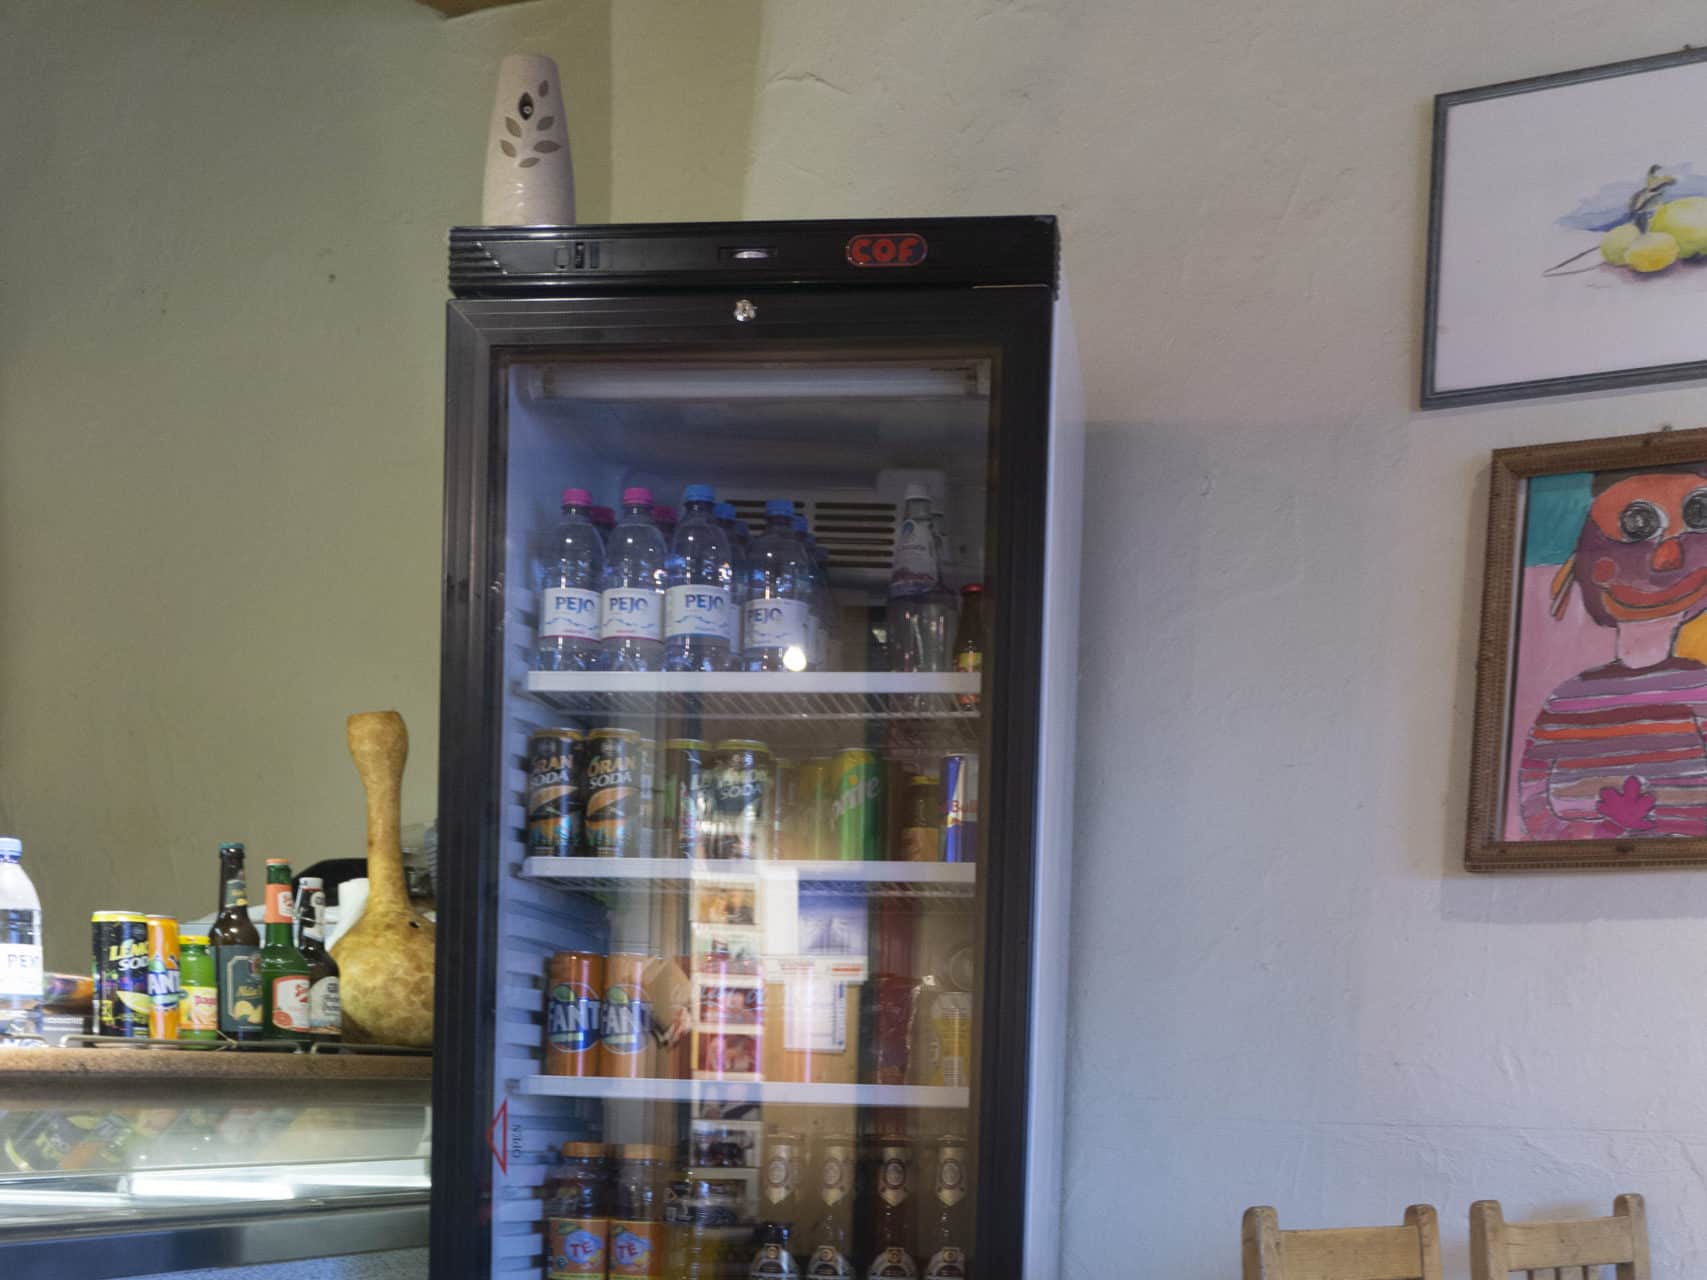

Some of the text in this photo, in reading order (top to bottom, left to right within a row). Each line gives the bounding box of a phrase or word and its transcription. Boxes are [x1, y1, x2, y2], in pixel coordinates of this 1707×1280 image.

[852, 238, 918, 262] COF
[555, 596, 595, 613] PEJO
[609, 597, 648, 613] PEJO
[685, 593, 724, 612] PEJO
[746, 606, 783, 624] PEJO
[590, 772, 632, 789] SODA
[110, 941, 149, 961] LEM
[8, 954, 41, 968] PEJ
[118, 956, 149, 972] SOD
[149, 969, 180, 996] ANT
[548, 1001, 600, 1032] FANT
[601, 1002, 653, 1034] FANT
[512, 1124, 521, 1159] OPEN
